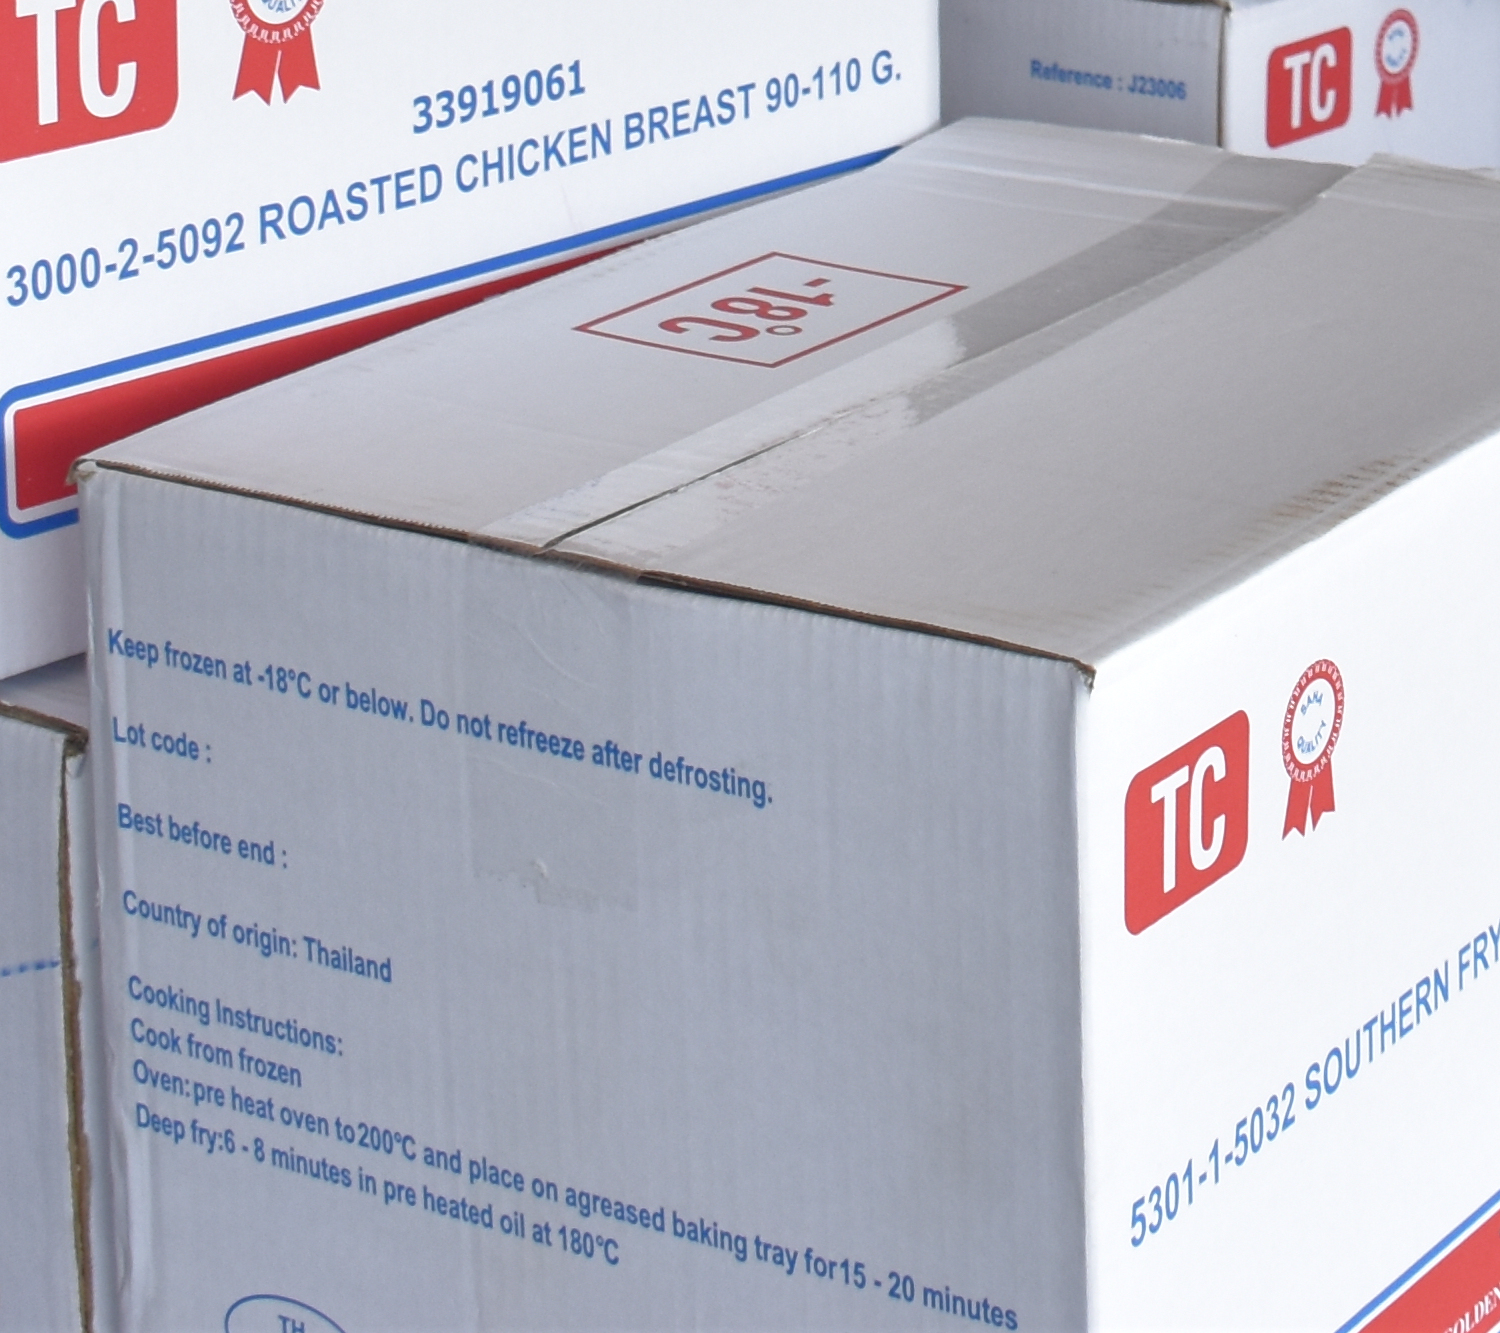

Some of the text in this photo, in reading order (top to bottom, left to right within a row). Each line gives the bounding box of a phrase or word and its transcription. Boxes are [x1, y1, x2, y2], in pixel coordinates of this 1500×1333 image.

[412, 60, 587, 134] 33919061
[1030, 59, 1186, 100] Reference J23006
[1283, 43, 1337, 130] TC
[5, 49, 901, 307] 3000-2-5092 ROASTED CHICKEN BREAST 90-110 G.
[657, 276, 835, 343] -18°C
[107, 627, 159, 668] Keep
[163, 640, 226, 680] frozen
[232, 660, 252, 686] at
[317, 682, 340, 705] or
[344, 681, 413, 723] below.
[419, 698, 450, 731] Do
[456, 713, 492, 741] not
[497, 719, 585, 761] refreeze
[591, 739, 643, 774] after
[648, 751, 772, 809] defrosting.
[112, 716, 199, 761] Lot code
[116, 802, 275, 866] Best before end
[1151, 745, 1226, 895] TC
[121, 889, 392, 983] Country of origin: Thailand
[127, 974, 342, 1056] Cooking Instructions:
[129, 1017, 302, 1088] Cook from frozen
[1130, 1081, 1295, 1248] 5301-1-5032
[1304, 959, 1449, 1110] SOUTHERN
[132, 1058, 190, 1097] Oven:
[192, 1081, 225, 1107] pre
[230, 1085, 275, 1122] heat
[279, 1105, 329, 1137] oven
[422, 1146, 462, 1175] and
[468, 1156, 525, 1192] place
[530, 1177, 558, 1202] on
[564, 1186, 665, 1233] agreased
[671, 1209, 747, 1263] baking
[753, 1234, 798, 1276] tray
[887, 1270, 915, 1303] 20
[922, 1285, 1020, 1332] minutes
[135, 1102, 185, 1145] Deep
[252, 1136, 265, 1163] 8
[270, 1146, 352, 1188] minutes
[357, 1165, 377, 1196] in
[382, 1179, 416, 1207] pre
[422, 1184, 493, 1229] heated
[498, 1210, 525, 1239] oil
[531, 1221, 552, 1247] at
